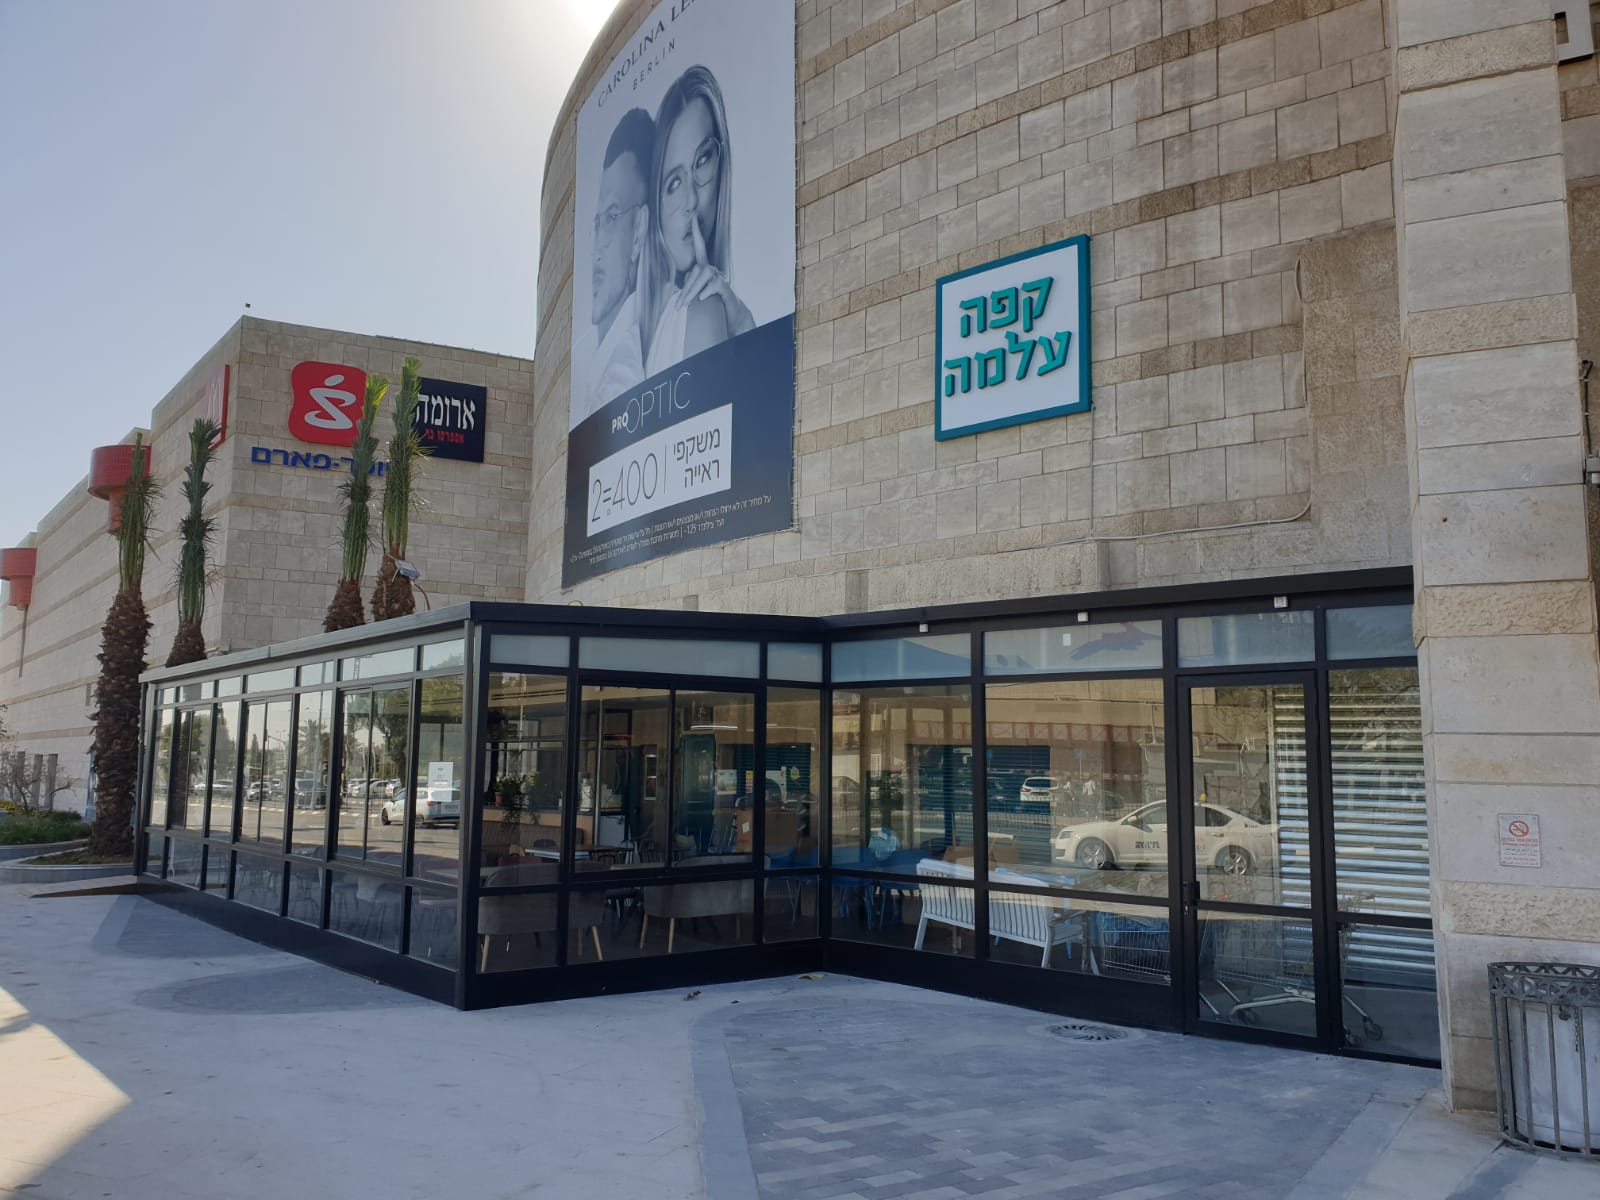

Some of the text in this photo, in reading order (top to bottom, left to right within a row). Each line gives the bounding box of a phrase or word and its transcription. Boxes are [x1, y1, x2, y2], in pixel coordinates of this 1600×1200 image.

[598, 0, 697, 108] CAROLINA LE
[633, 37, 675, 91] BERLIN
[959, 276, 1054, 339] קפה
[943, 330, 1073, 398] עלמה
[415, 391, 477, 431] ארומה
[673, 427, 721, 465] משקפי
[684, 458, 721, 489] ראייה
